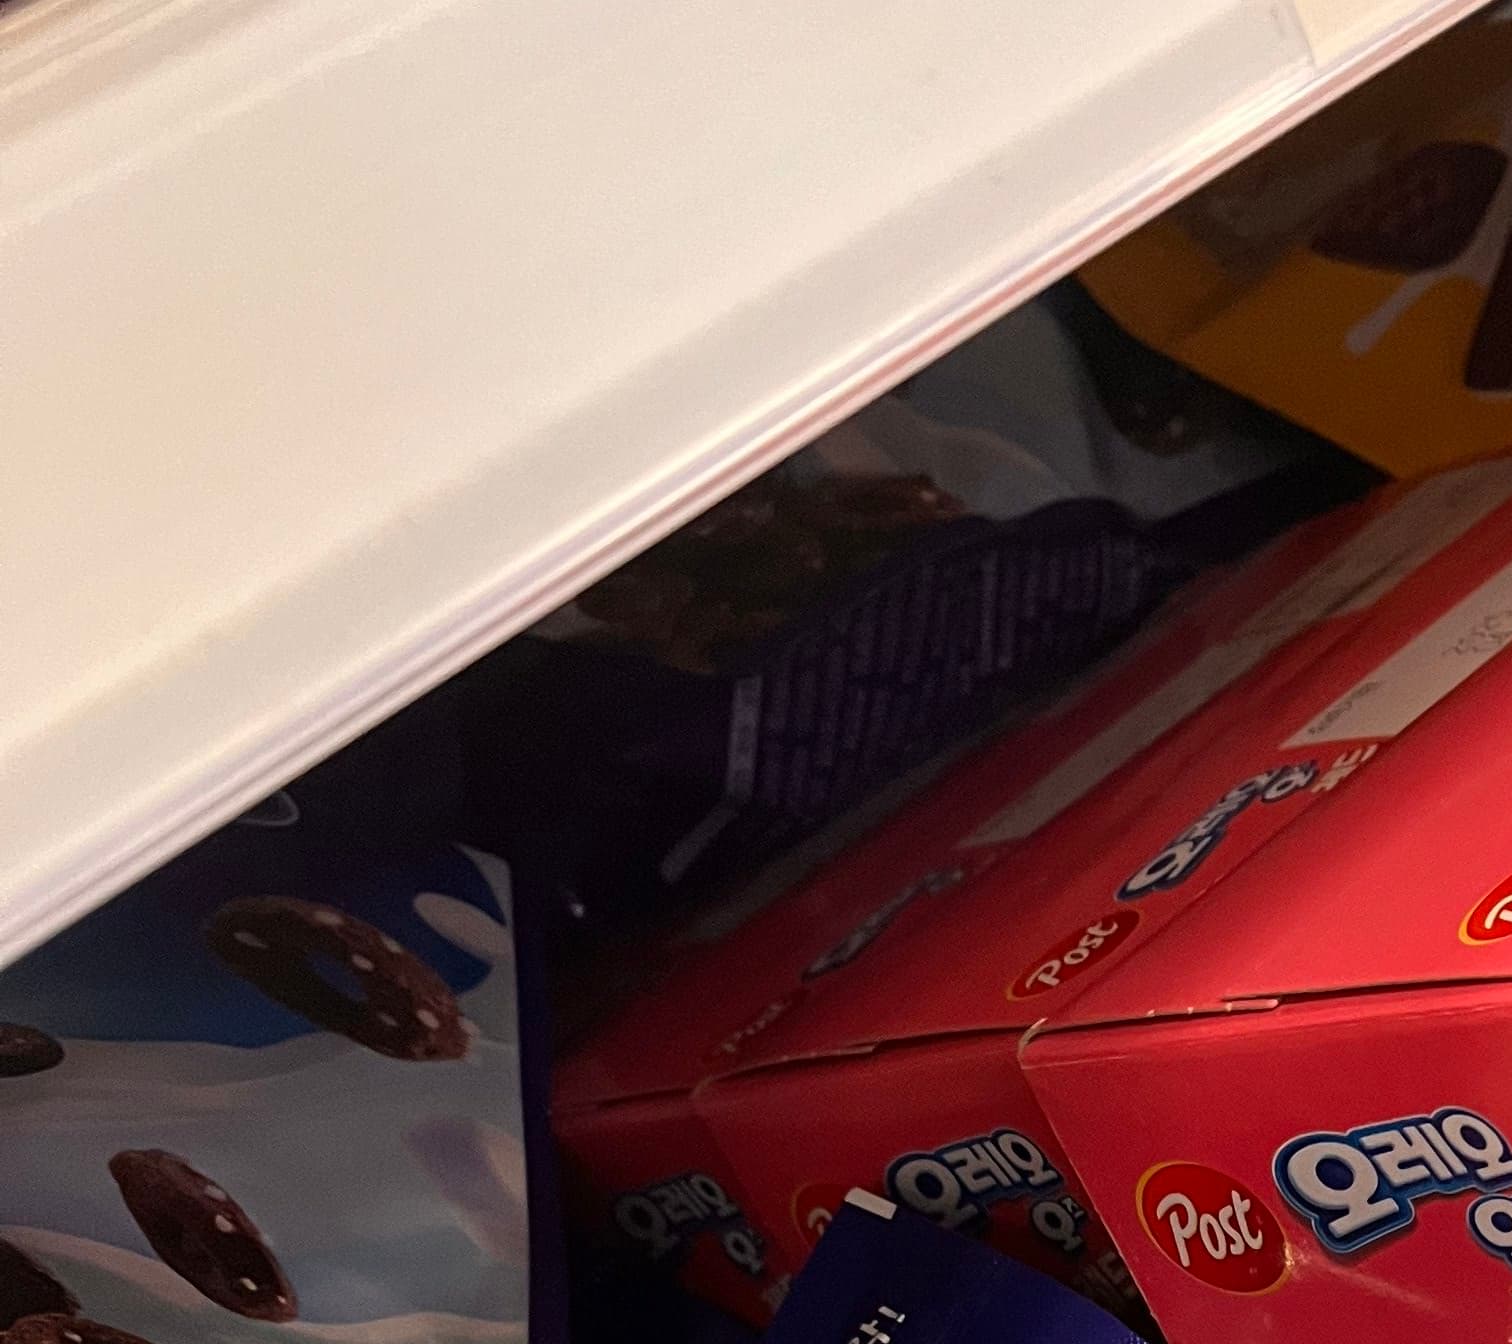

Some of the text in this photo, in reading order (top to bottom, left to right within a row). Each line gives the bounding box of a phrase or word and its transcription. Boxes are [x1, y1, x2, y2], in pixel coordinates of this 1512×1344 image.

[1025, 922, 1119, 988] Post
[897, 1134, 1059, 1226] 오레오
[1156, 1190, 1263, 1268] Post
